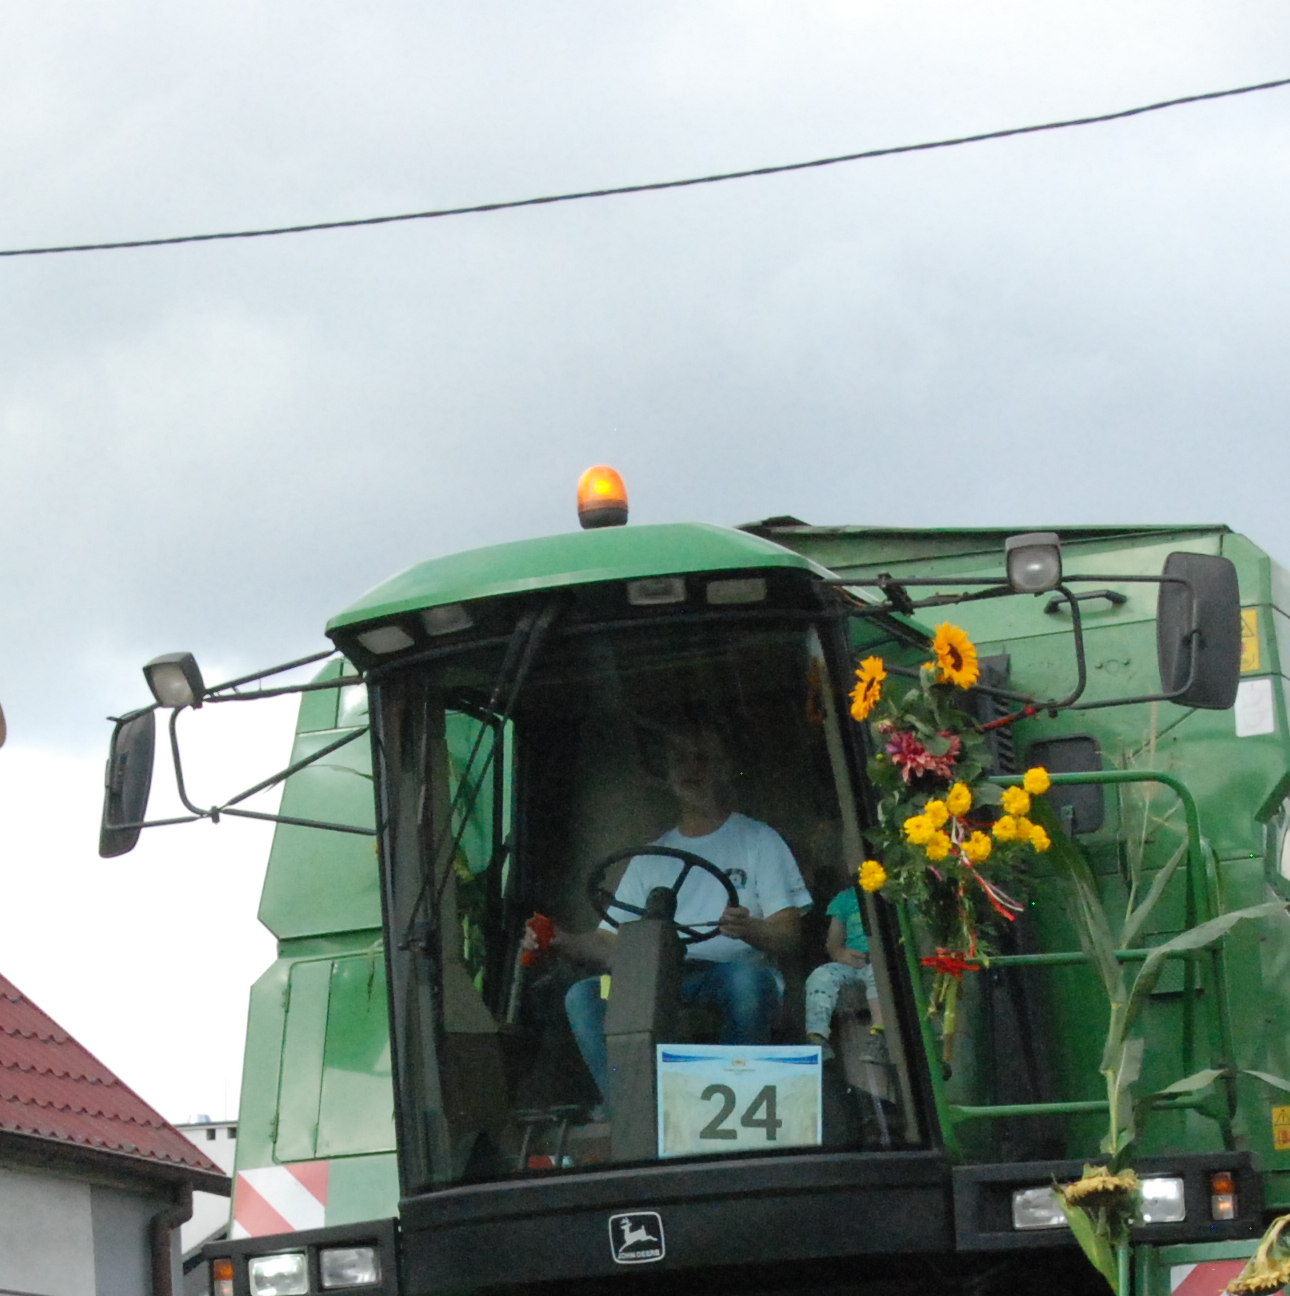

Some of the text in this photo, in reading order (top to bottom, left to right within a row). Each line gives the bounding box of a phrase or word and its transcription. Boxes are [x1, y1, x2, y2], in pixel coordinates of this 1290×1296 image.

[699, 1083, 783, 1141] 24
[618, 1249, 660, 1260] JOHN DEERE
